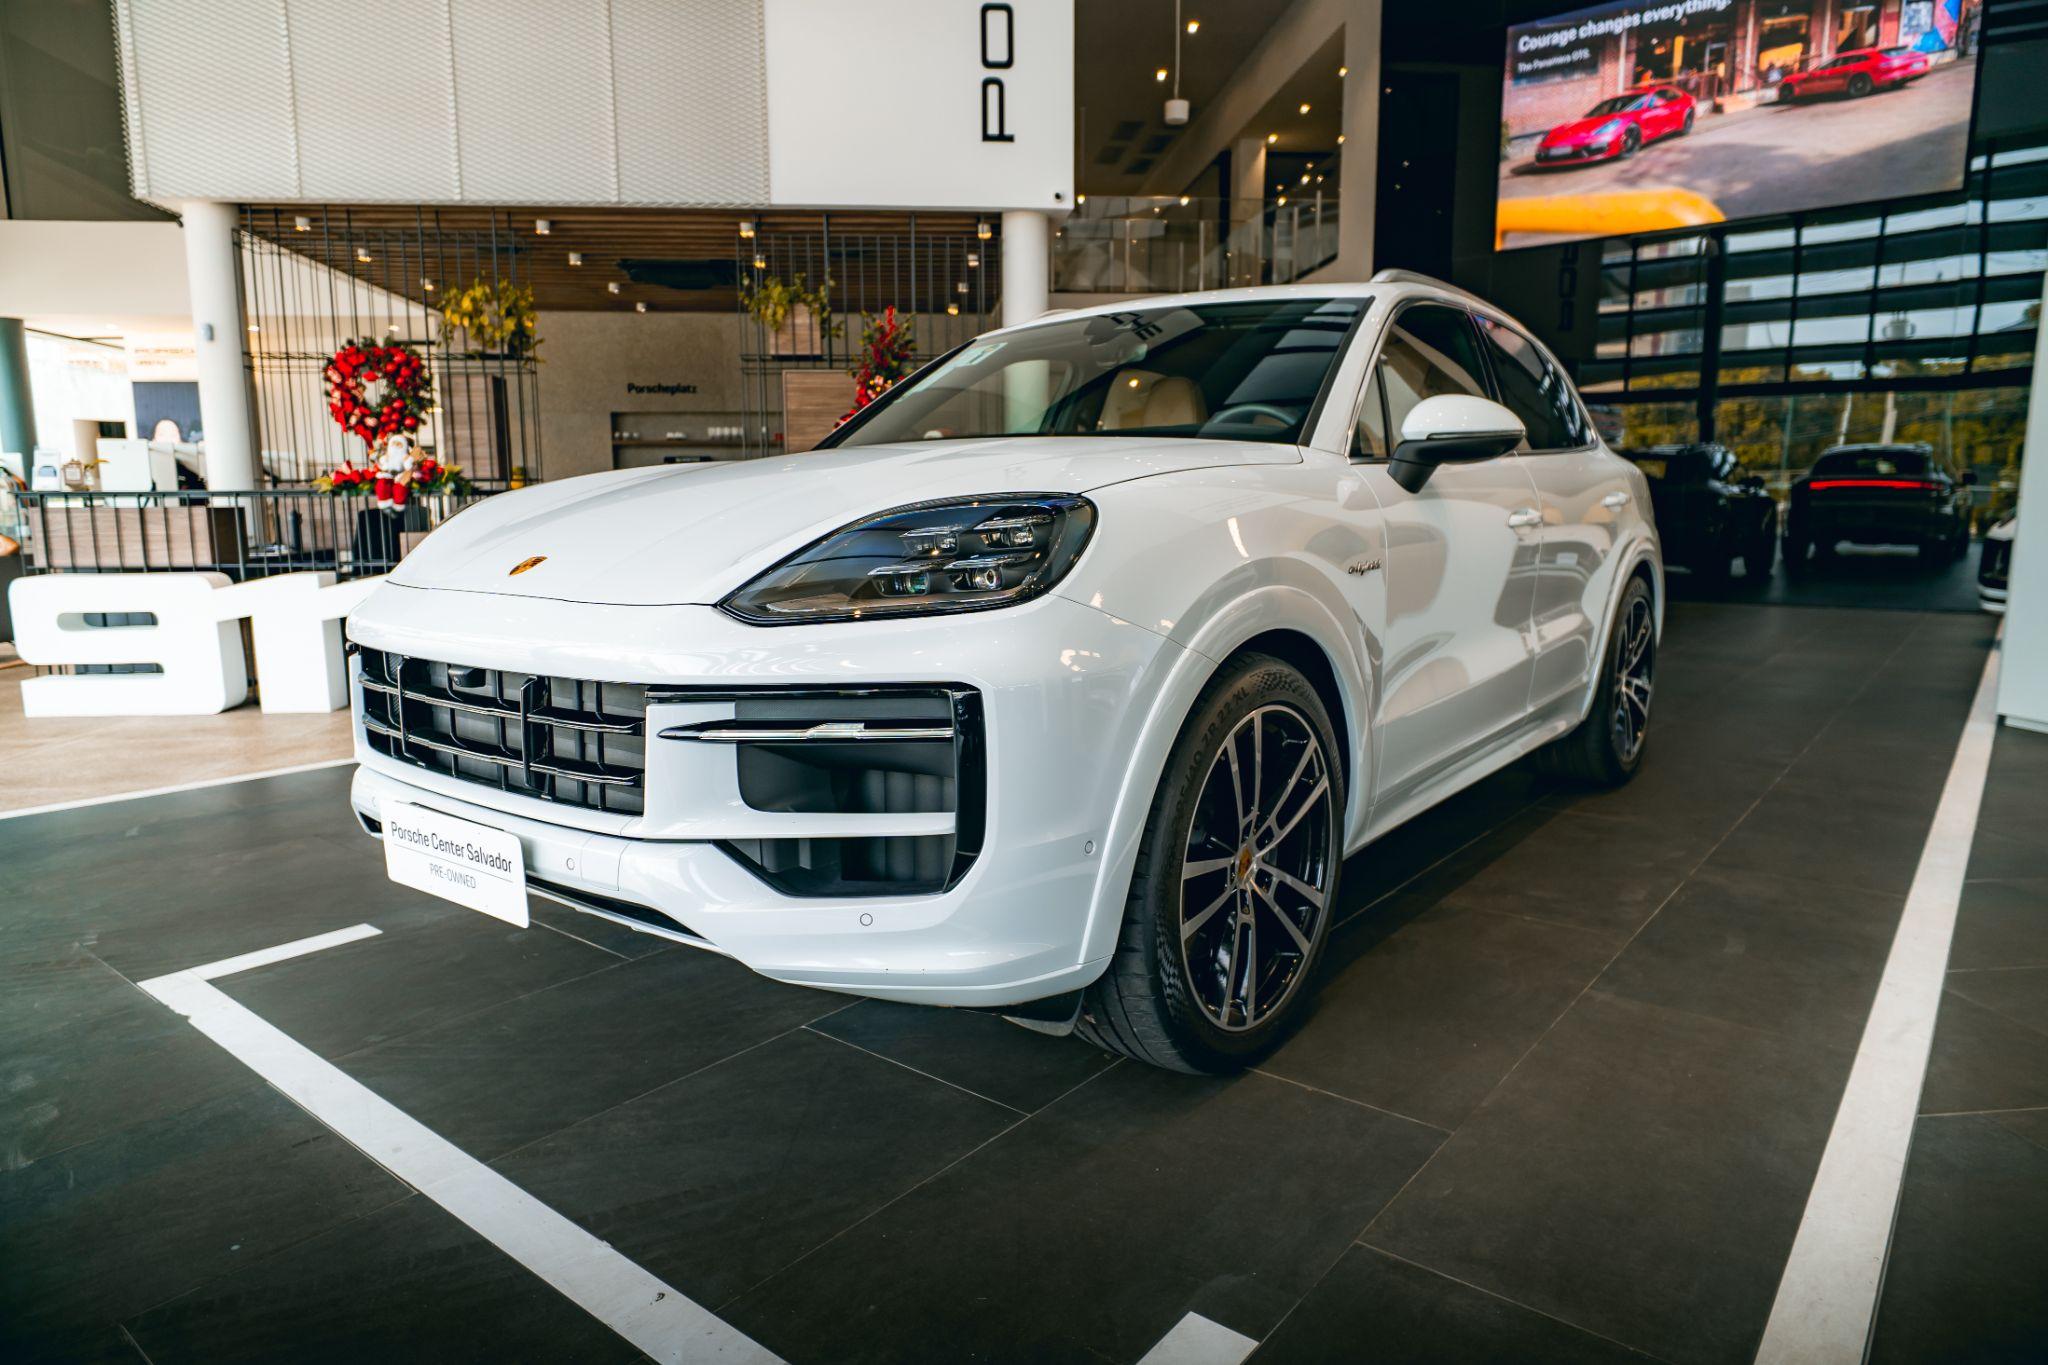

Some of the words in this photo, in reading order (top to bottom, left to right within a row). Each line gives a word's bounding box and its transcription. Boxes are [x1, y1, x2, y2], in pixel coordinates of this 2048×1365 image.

[1518, 28, 1578, 53] Courage
[1579, 13, 1641, 39] changes
[1643, 0, 1731, 24] everything.
[981, 3, 1015, 143] PO
[627, 382, 698, 397] Porscheplatz
[8, 571, 390, 718] 91
[1217, 701, 1234, 724] 22
[1232, 686, 1250, 705] XL
[391, 821, 430, 847] Porsche
[431, 832, 466, 859] Center
[466, 843, 512, 873] Salvador
[428, 862, 477, 889] PRE-OWNED
